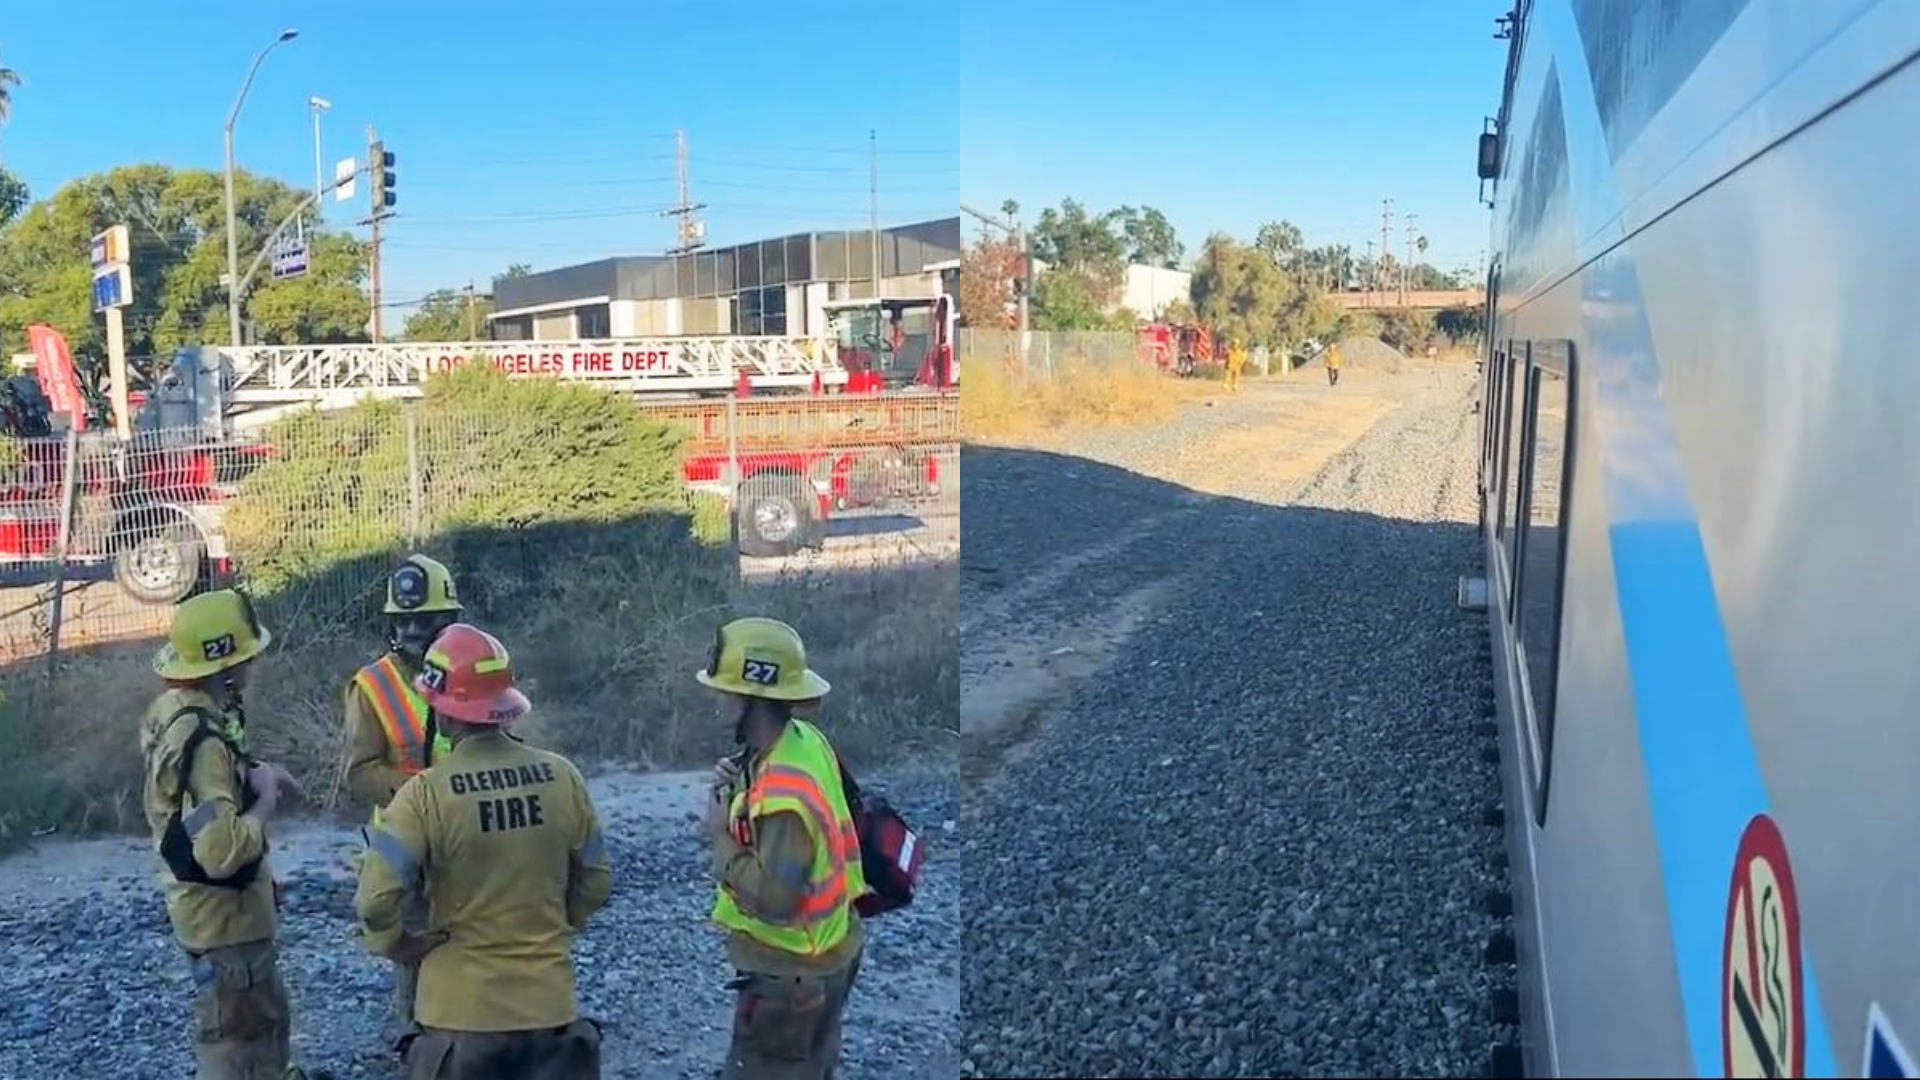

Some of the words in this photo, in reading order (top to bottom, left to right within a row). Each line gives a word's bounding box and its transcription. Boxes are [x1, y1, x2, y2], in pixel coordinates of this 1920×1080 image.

[488, 353, 564, 374] NGELES
[573, 353, 612, 372] FIRE
[622, 351, 672, 370] DEPT.
[206, 636, 231, 658] 27
[423, 663, 443, 688] 27
[745, 662, 777, 682] 27
[450, 763, 555, 795] GLENDALE
[478, 795, 543, 832] FIRE
